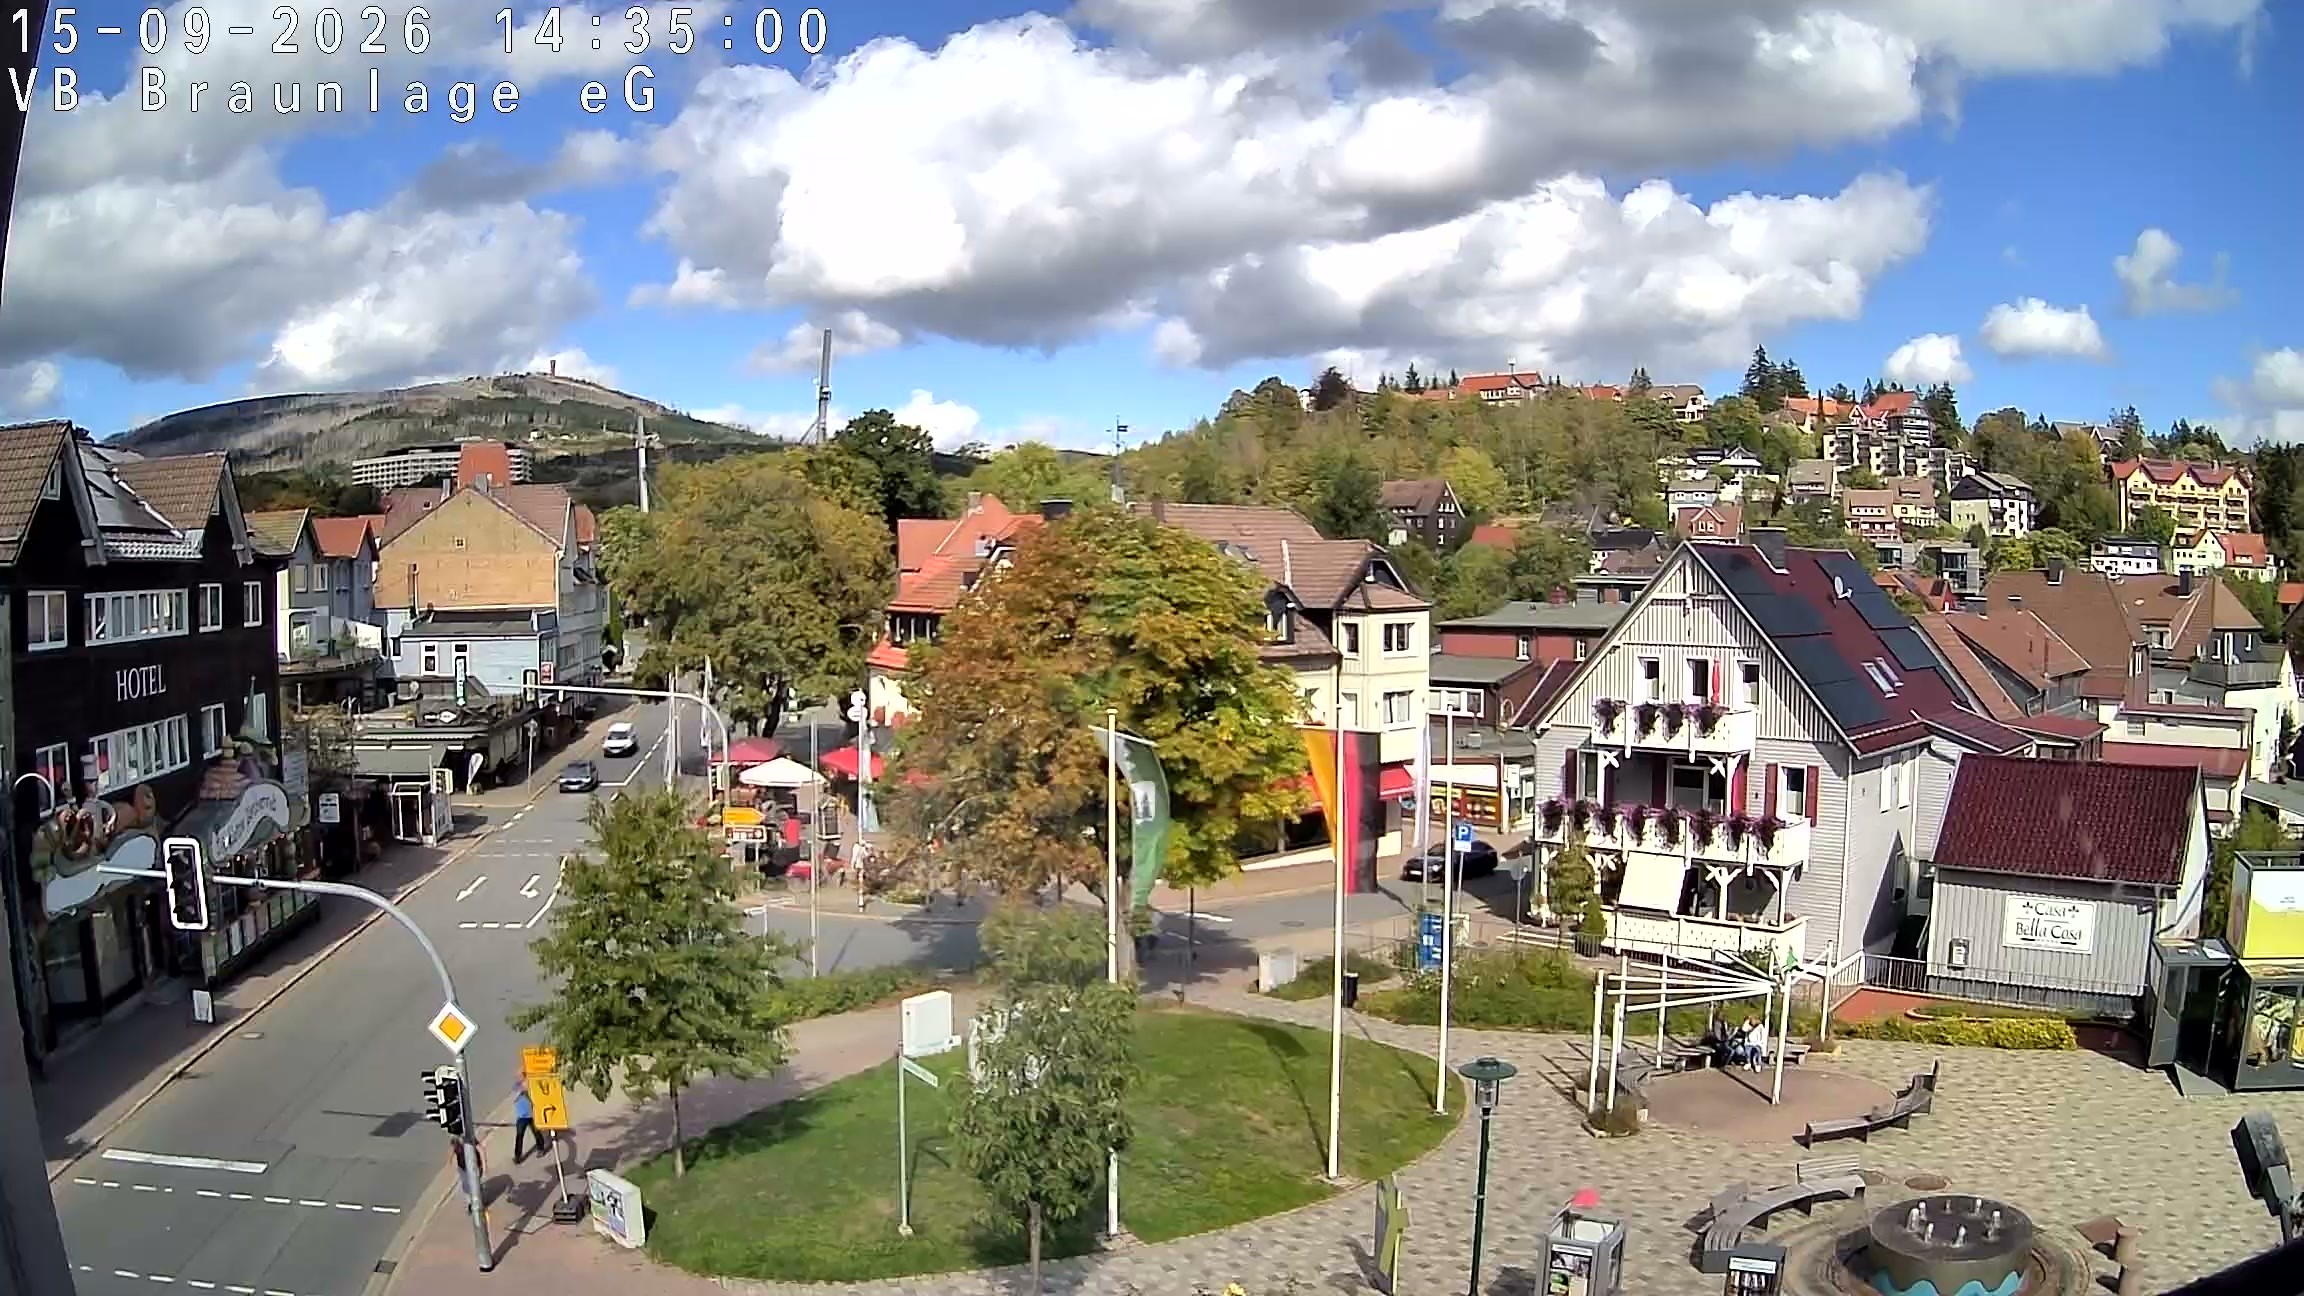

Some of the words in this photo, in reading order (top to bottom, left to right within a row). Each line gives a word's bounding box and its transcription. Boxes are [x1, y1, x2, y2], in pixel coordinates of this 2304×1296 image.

[116, 664, 167, 702] HOTEL
[1458, 826, 1469, 840] P
[2016, 918, 2047, 938] Bella
